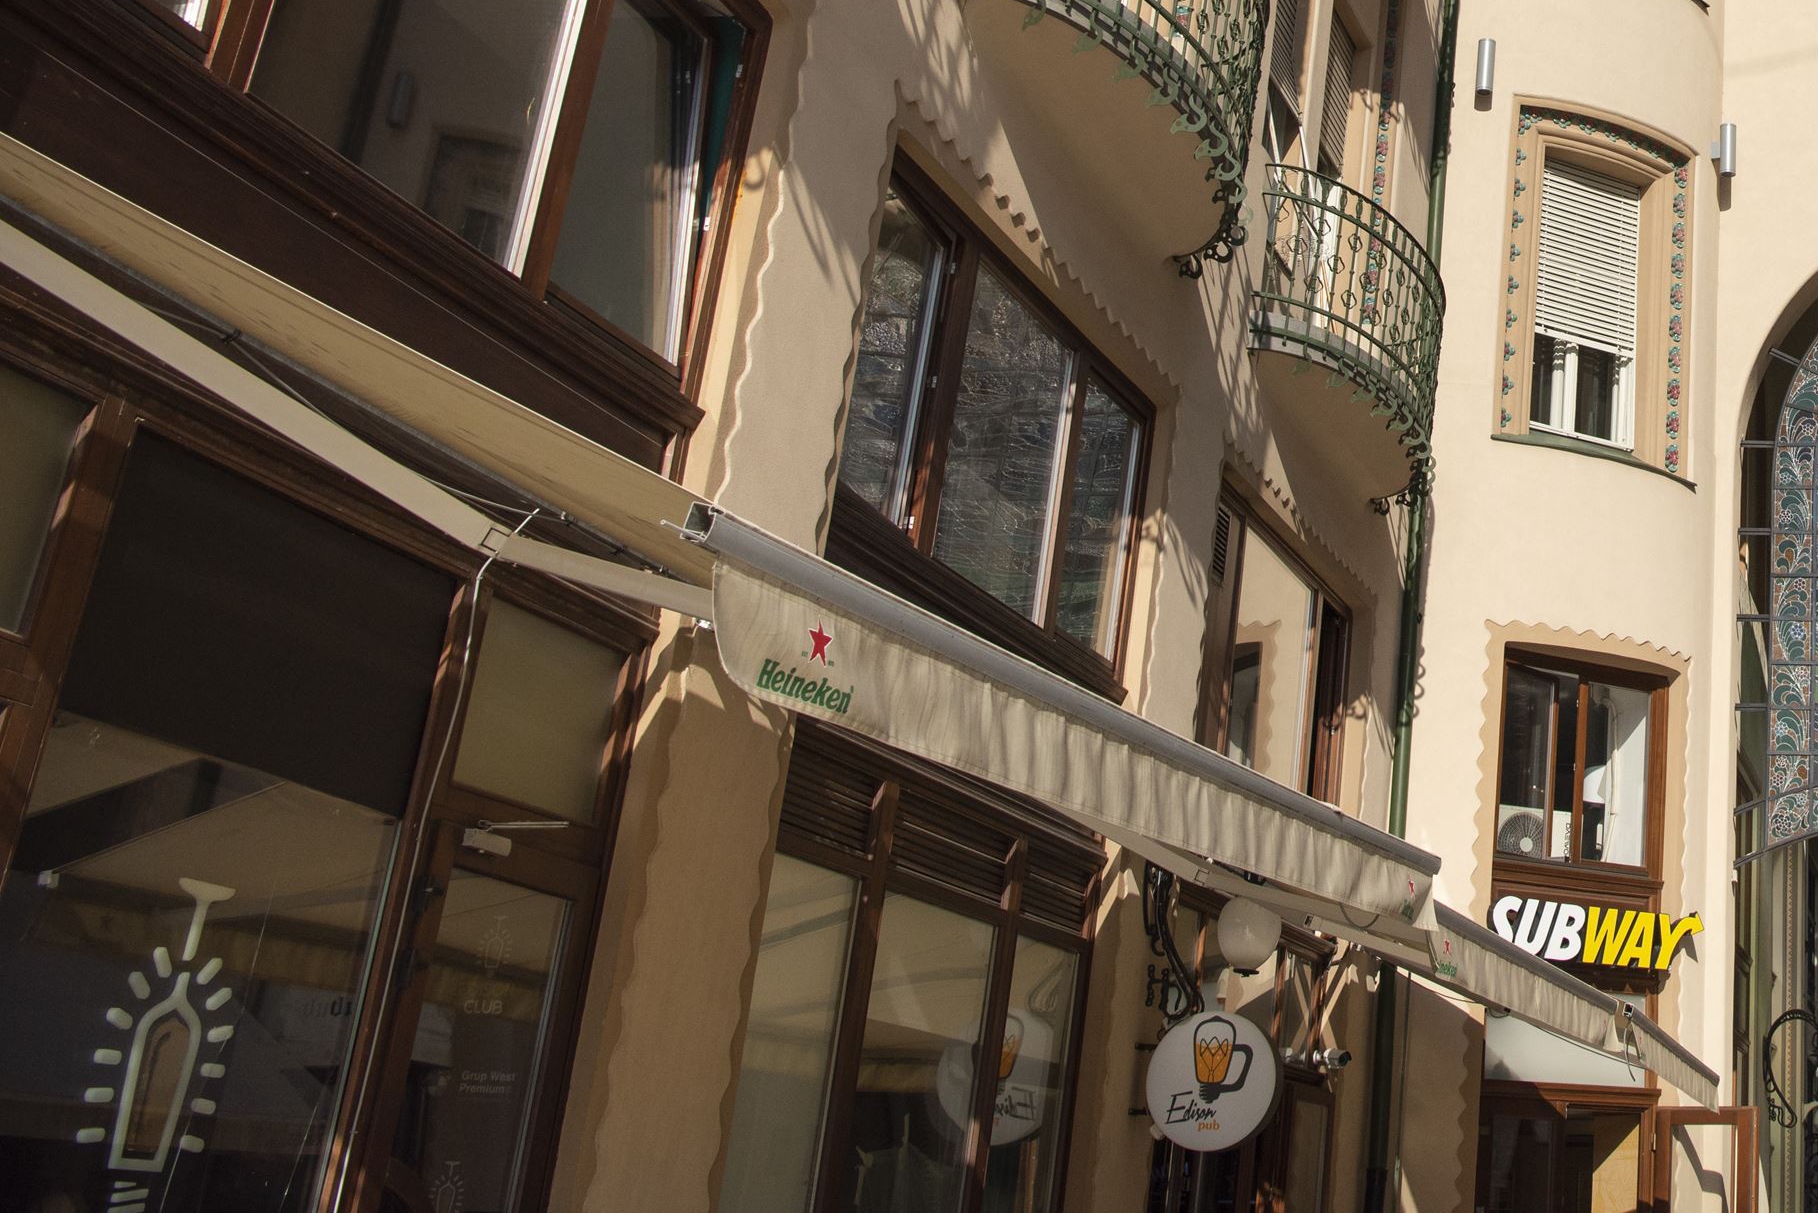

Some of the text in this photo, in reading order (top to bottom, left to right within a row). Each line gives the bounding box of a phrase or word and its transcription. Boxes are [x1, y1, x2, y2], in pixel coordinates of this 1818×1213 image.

[757, 658, 853, 714] Heineken
[1493, 895, 1704, 970] SUBWAY
[464, 999, 503, 1014] CLUB
[462, 1070, 487, 1083] Grup
[1165, 1090, 1216, 1124] Edison
[1197, 1120, 1220, 1132] pub
